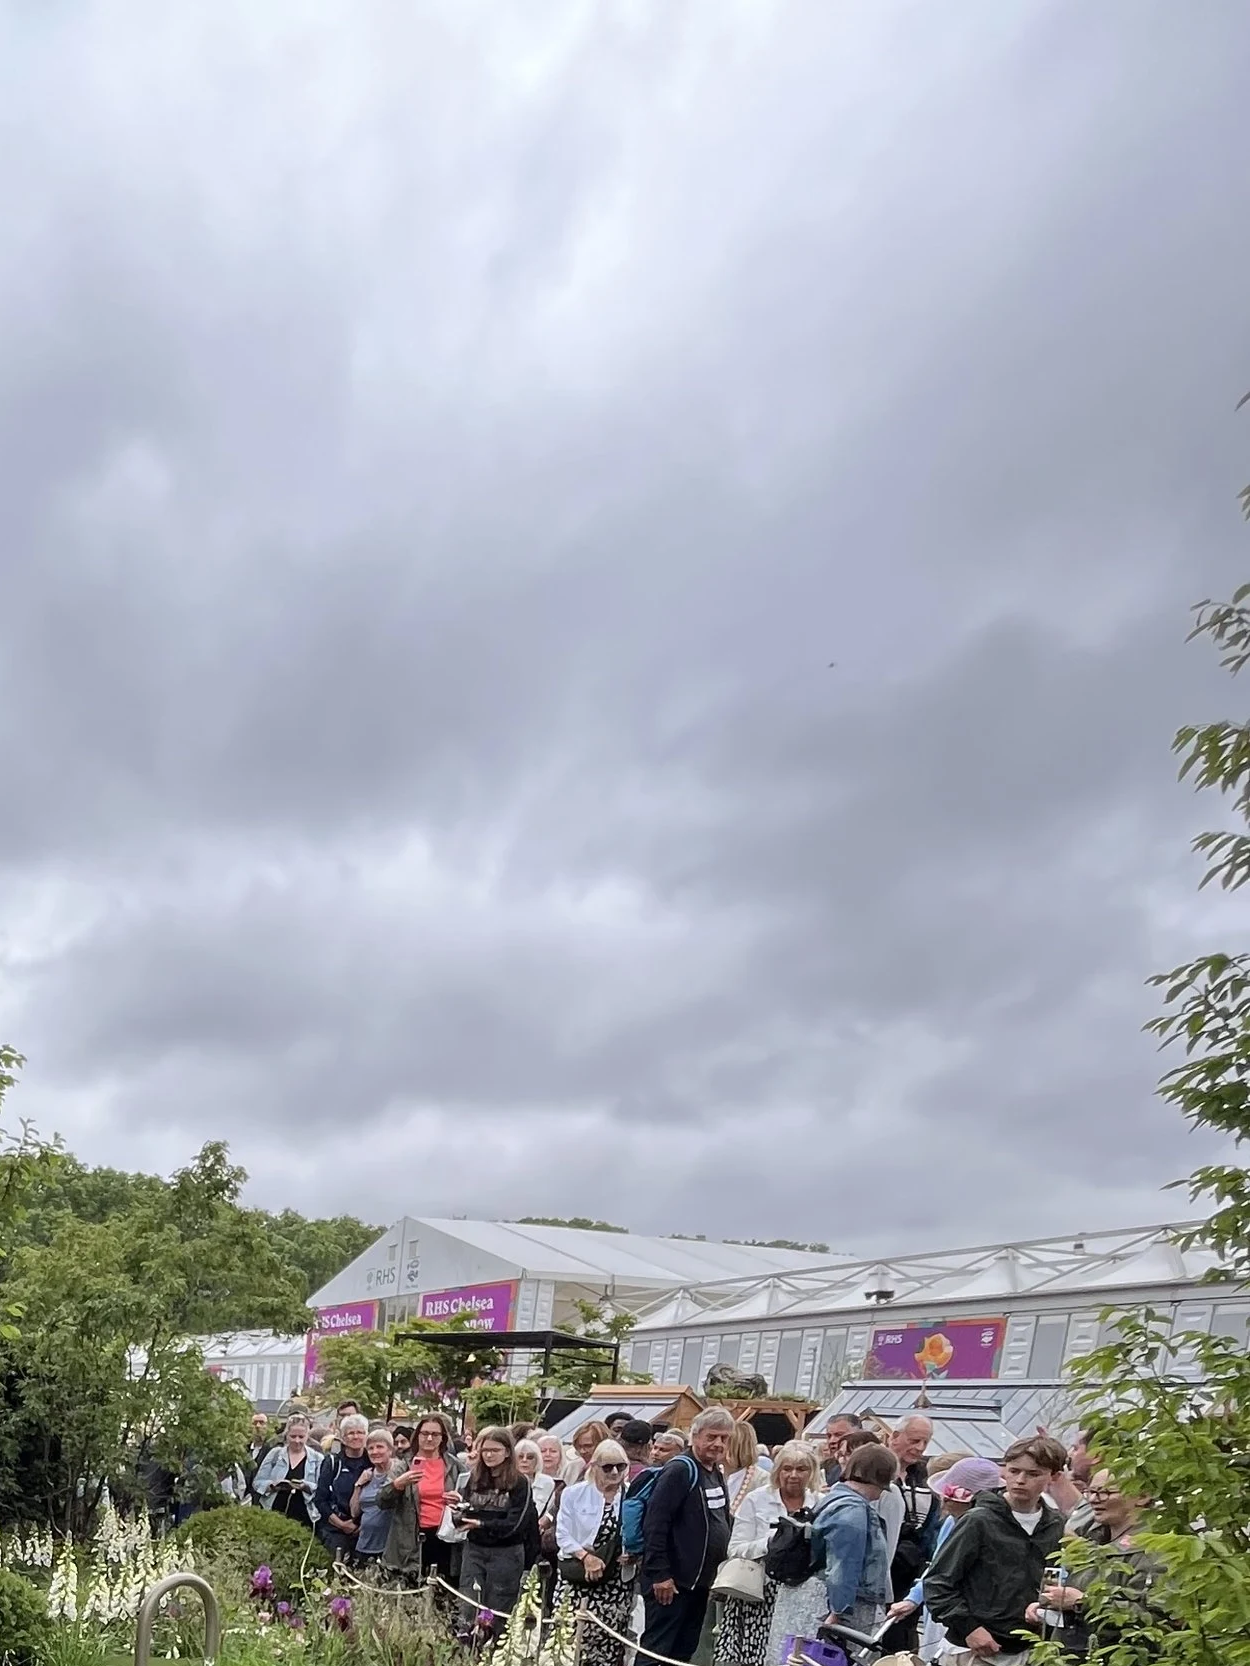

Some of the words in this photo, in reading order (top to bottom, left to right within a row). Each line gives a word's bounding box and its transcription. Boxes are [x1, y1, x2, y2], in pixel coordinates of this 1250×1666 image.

[376, 1267, 396, 1286] RHS
[425, 1299, 450, 1316] RHS
[450, 1295, 494, 1314] Chelsea
[330, 1312, 362, 1328] Chelsea
[885, 1334, 903, 1344] RHS
